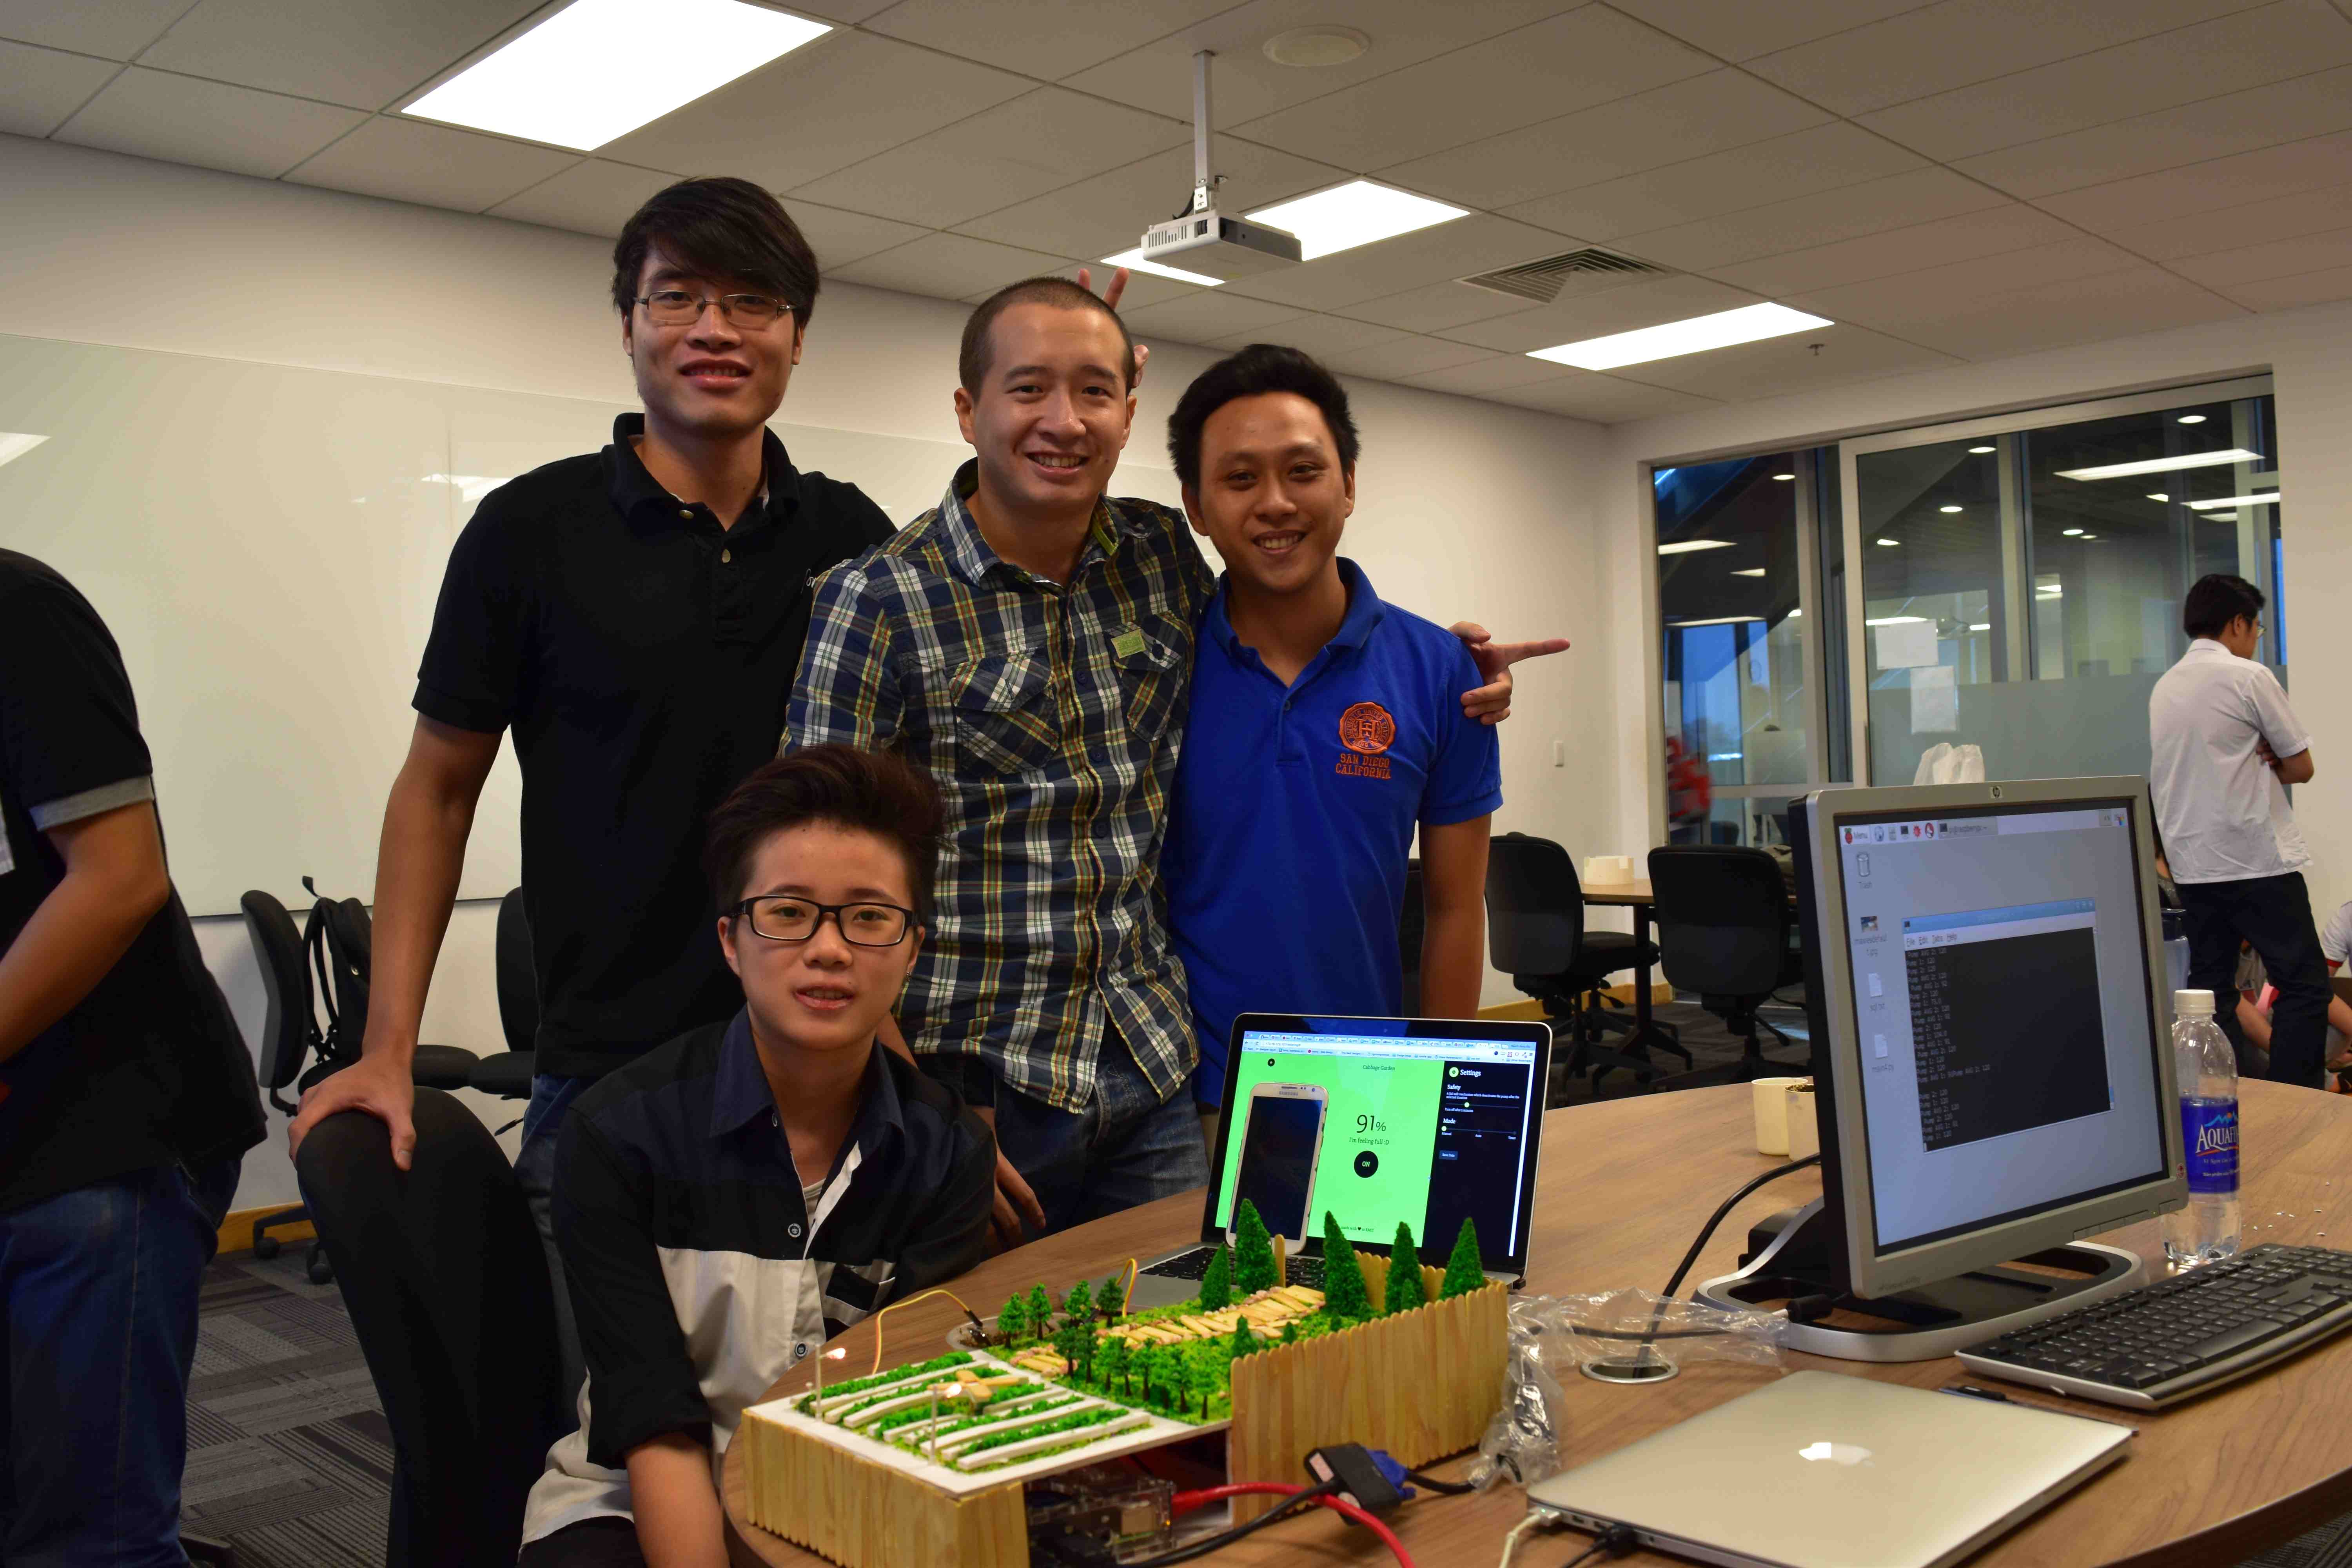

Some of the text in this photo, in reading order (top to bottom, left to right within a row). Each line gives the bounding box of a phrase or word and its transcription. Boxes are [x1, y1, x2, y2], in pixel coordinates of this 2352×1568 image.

[1340, 753, 1390, 768] SAN DIEGO
[1336, 764, 1392, 779] CALIFORNIA
[1906, 932, 1957, 947] File Edit Tabs Help
[1355, 1114, 1387, 1134] 91%
